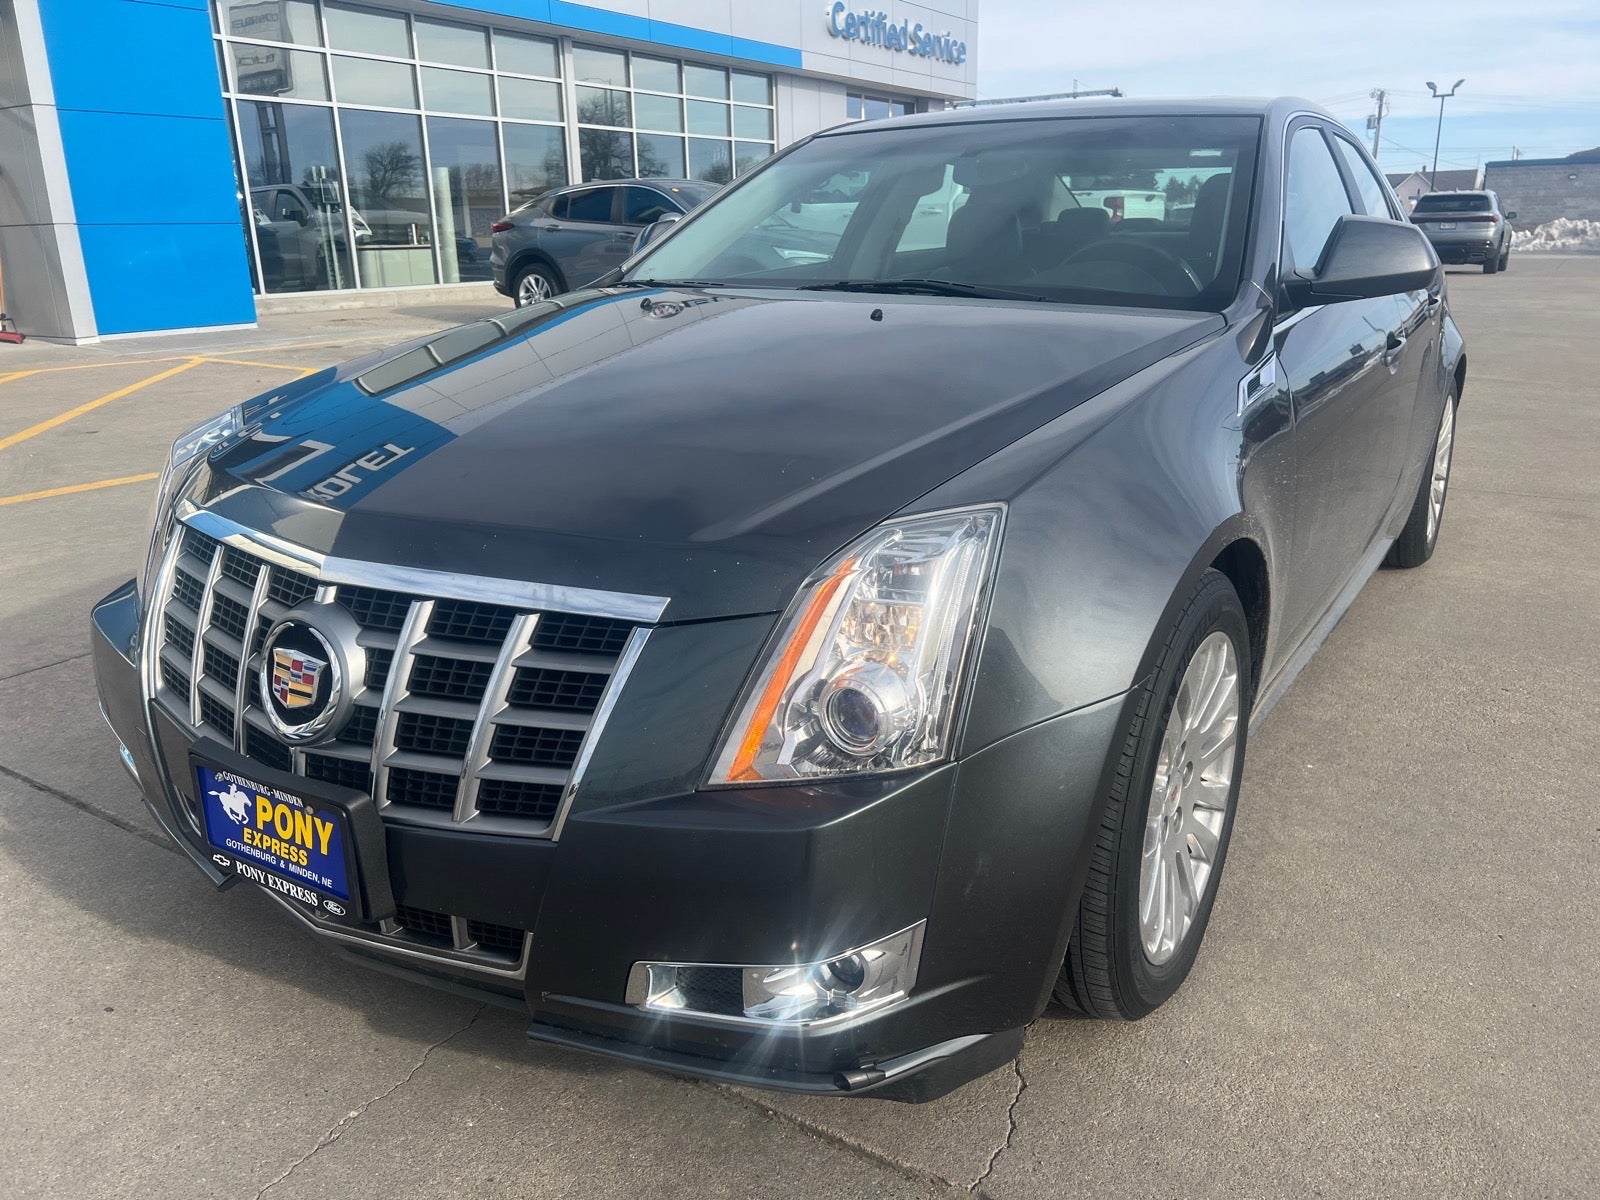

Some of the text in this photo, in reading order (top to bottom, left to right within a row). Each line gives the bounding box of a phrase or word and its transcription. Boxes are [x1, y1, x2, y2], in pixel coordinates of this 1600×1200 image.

[830, 1, 967, 64] Certified Service
[243, 827, 308, 867] EXPRESS
[255, 794, 334, 856] PONY
[225, 838, 333, 888] GOTHENBURG & MINDEN, NE
[235, 860, 266, 883] PONY
[267, 873, 319, 907] EXPRESS
